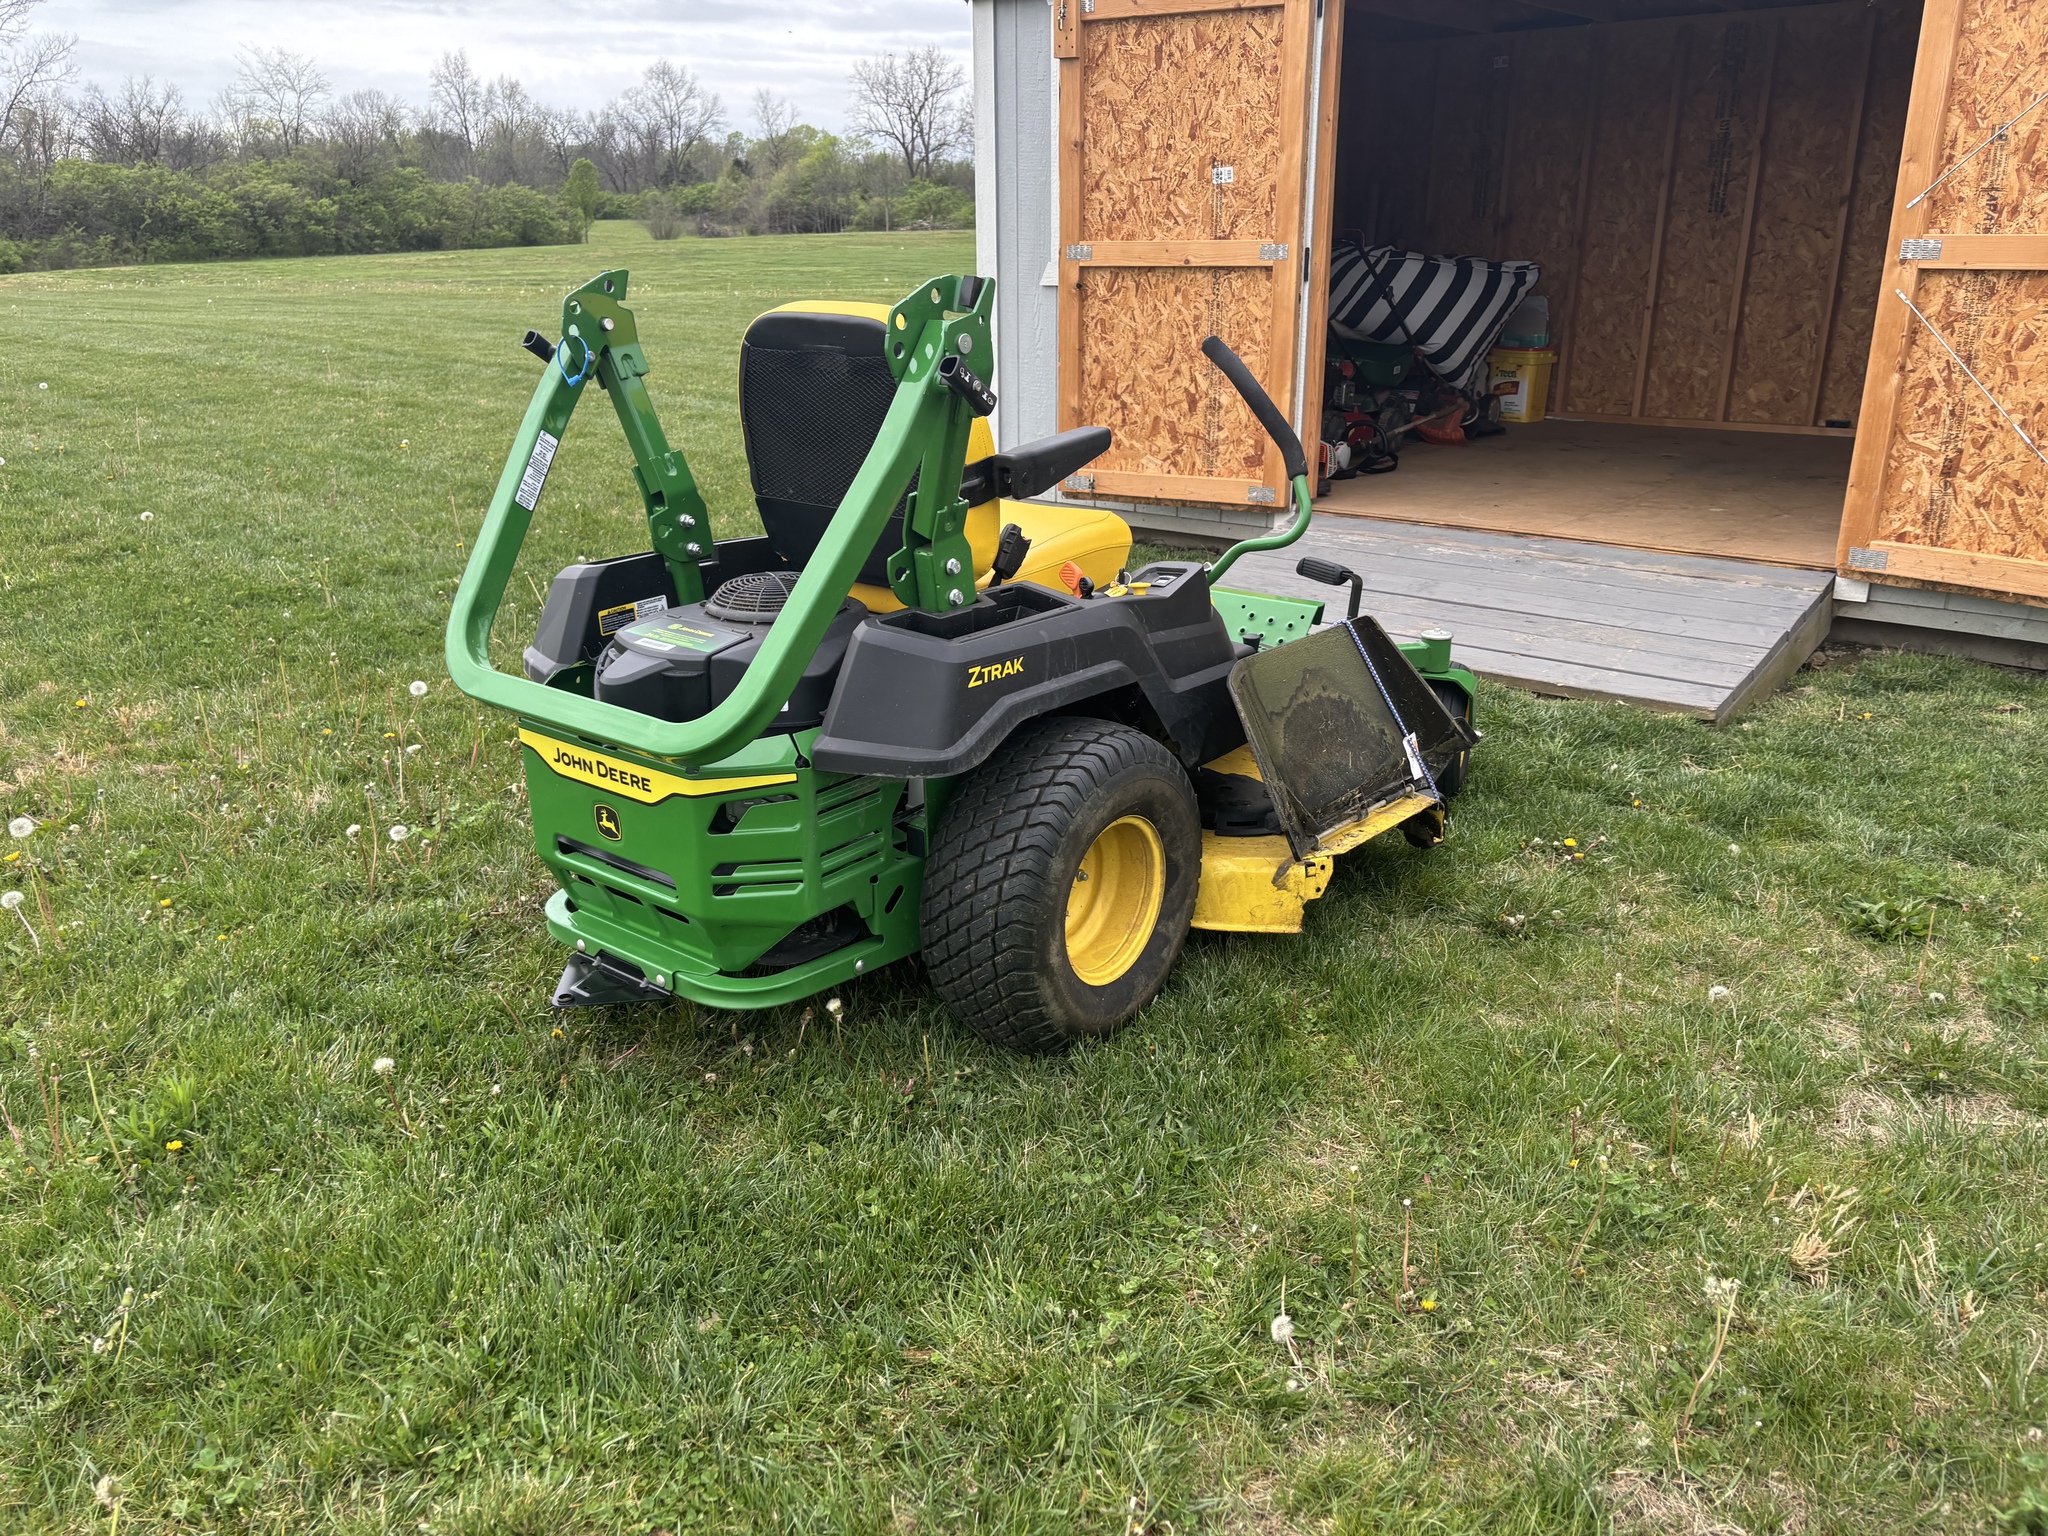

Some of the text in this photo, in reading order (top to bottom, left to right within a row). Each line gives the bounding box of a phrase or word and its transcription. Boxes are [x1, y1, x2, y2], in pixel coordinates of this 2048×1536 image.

[968, 656, 1024, 689] ZTRAK
[553, 747, 652, 793] JOHN DEERE
